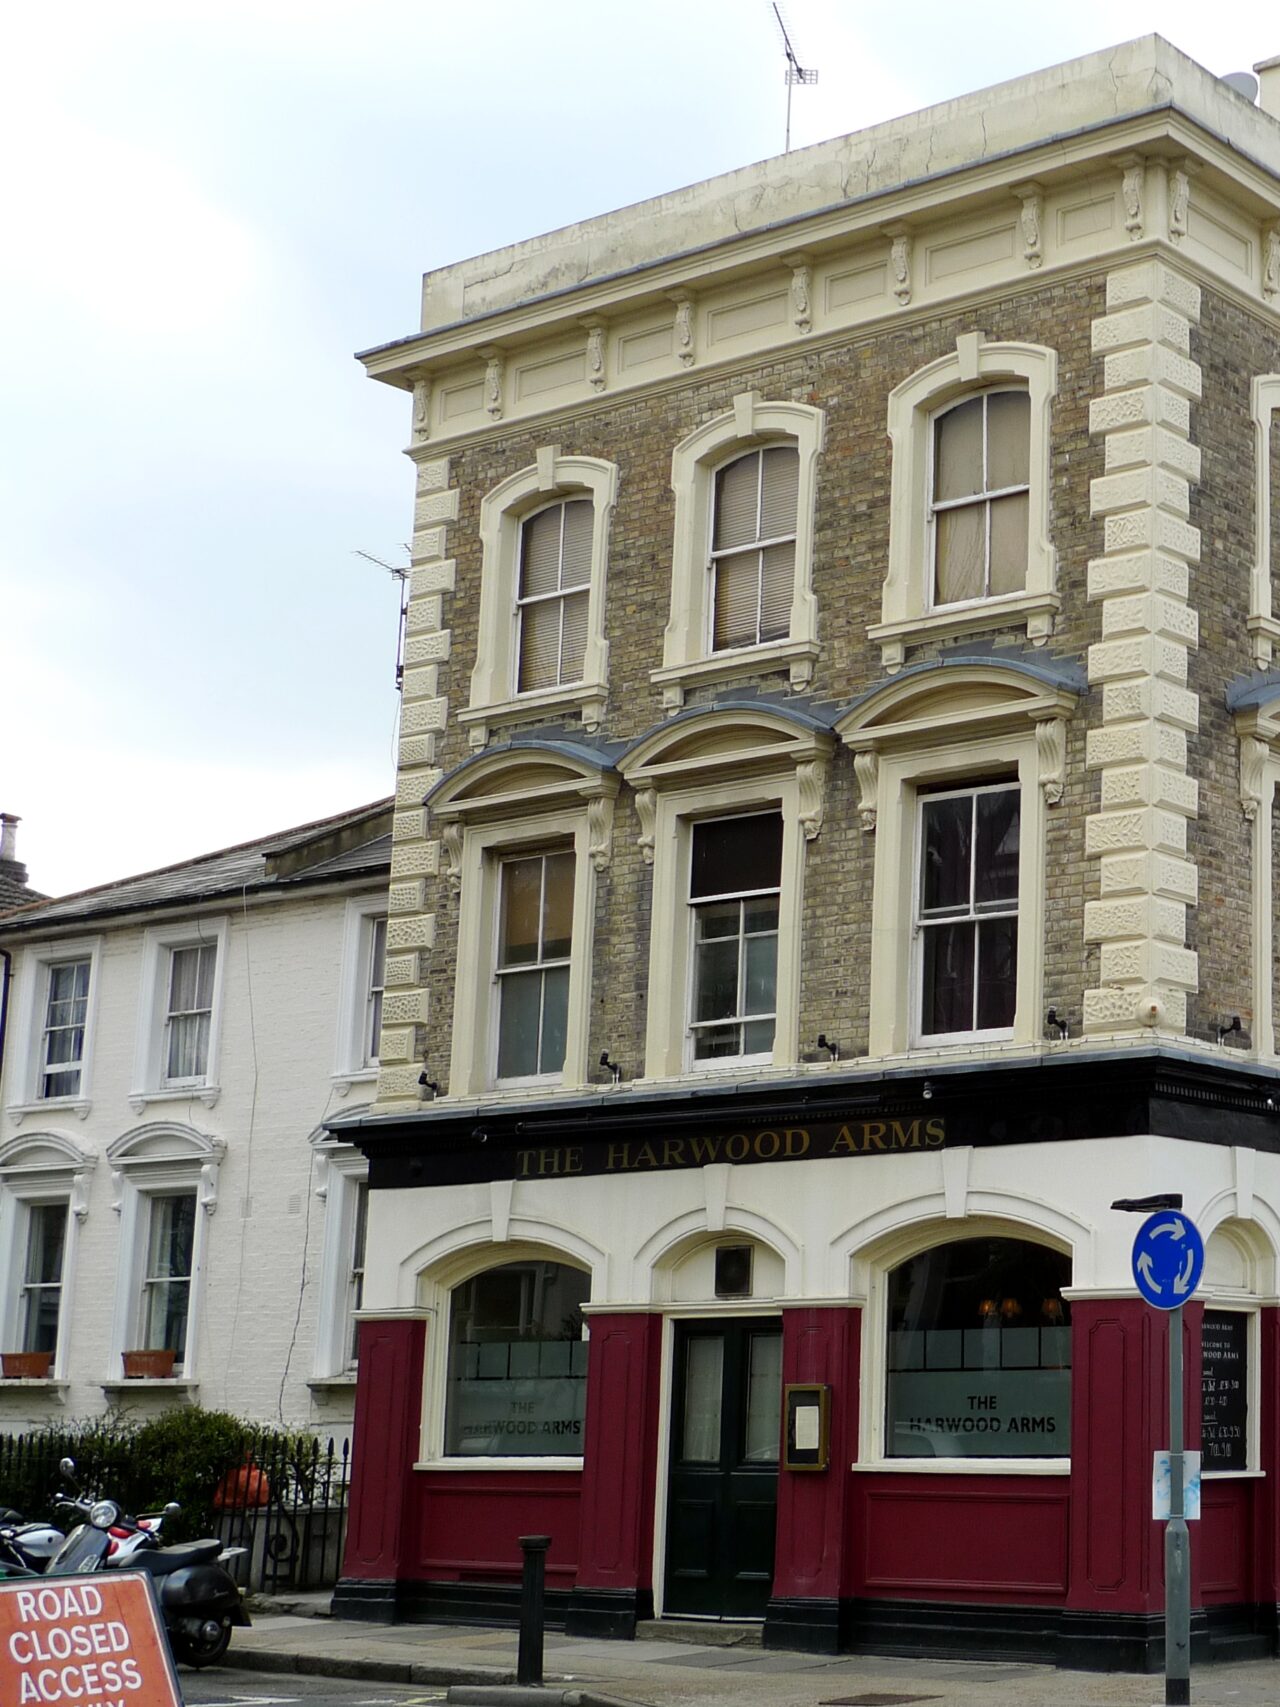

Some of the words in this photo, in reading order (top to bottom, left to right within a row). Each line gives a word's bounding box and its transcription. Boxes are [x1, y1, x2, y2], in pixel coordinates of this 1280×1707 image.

[517, 1146, 584, 1176] THE
[606, 1128, 811, 1170] HARWOOD
[829, 1116, 947, 1154] ARMS
[510, 1401, 536, 1414] THE
[967, 1395, 998, 1411] THE
[542, 1420, 582, 1435] ARMS
[909, 1416, 1002, 1433] HARWOOD
[1006, 1416, 1057, 1433] ARMS
[17, 1585, 103, 1623] ROAD
[9, 1620, 130, 1664] CLOSED
[20, 1658, 143, 1704] ACCESS
